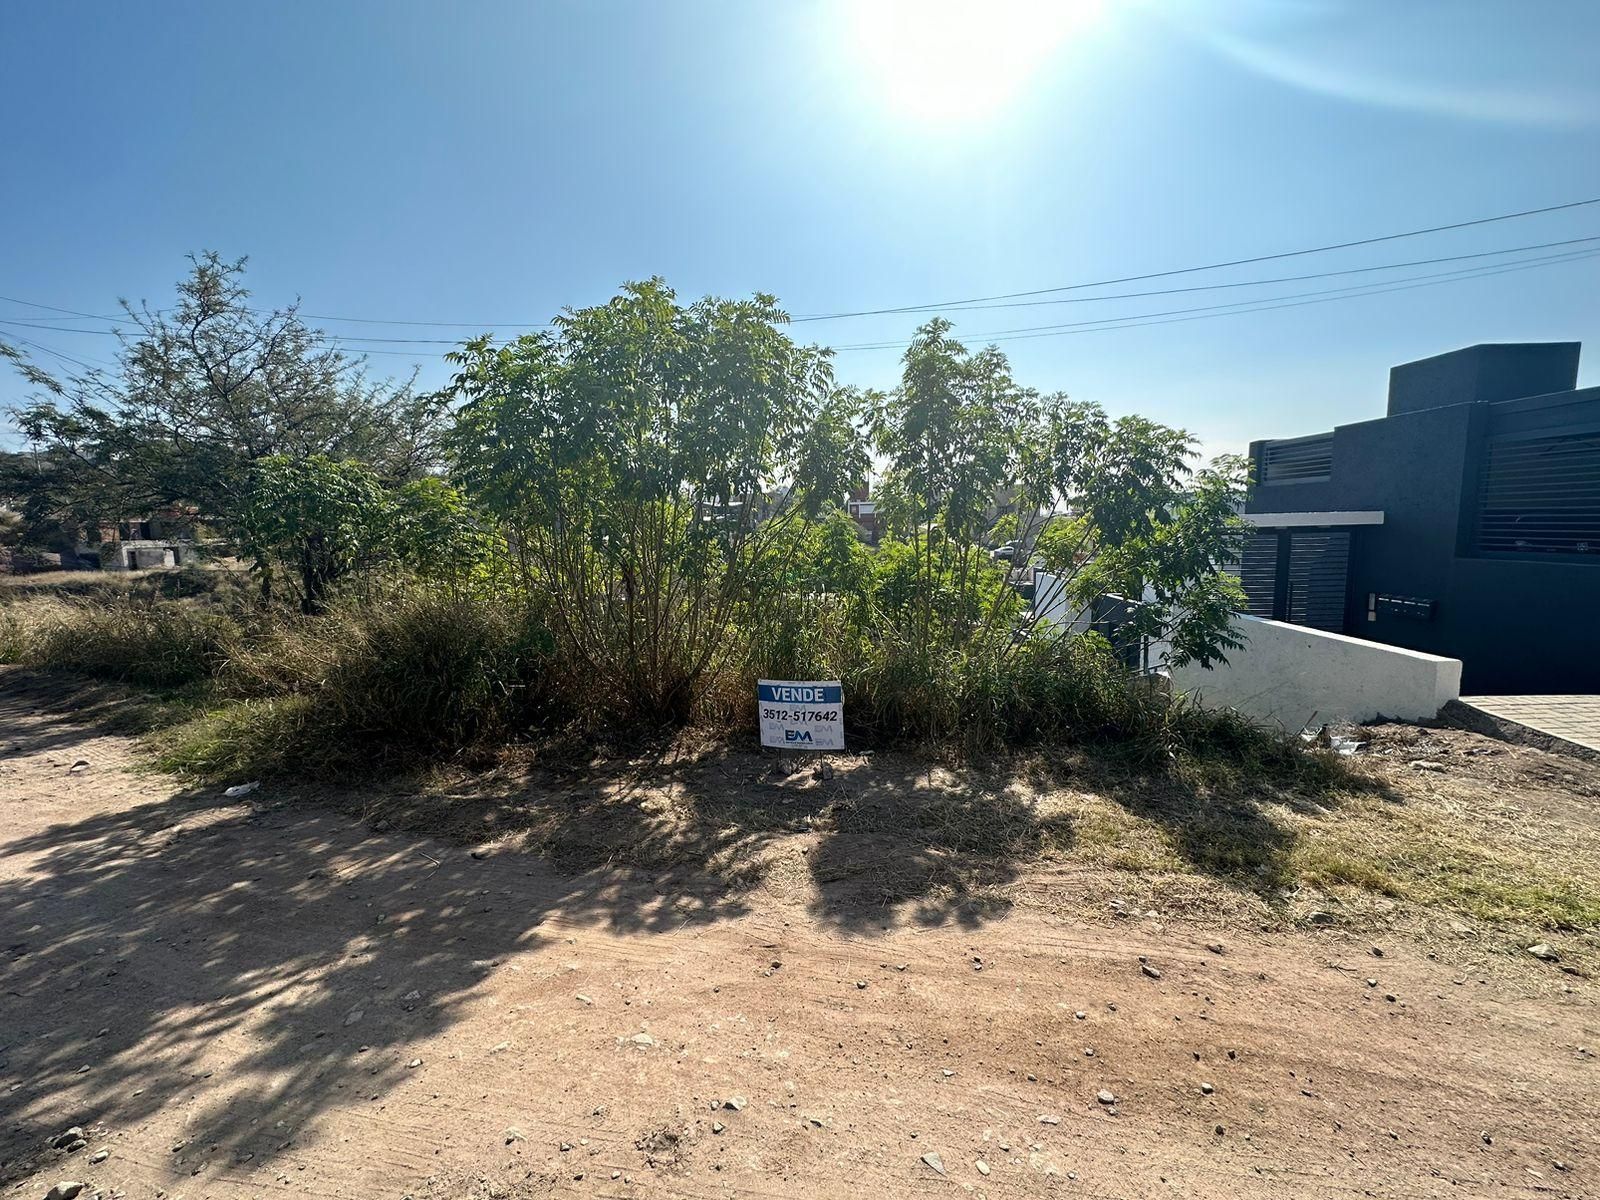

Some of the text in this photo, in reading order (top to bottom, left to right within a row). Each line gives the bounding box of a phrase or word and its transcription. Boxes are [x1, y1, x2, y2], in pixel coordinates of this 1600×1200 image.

[771, 687, 824, 702] VENDE
[763, 708, 838, 722] 3512-517642
[785, 729, 813, 742] EM
